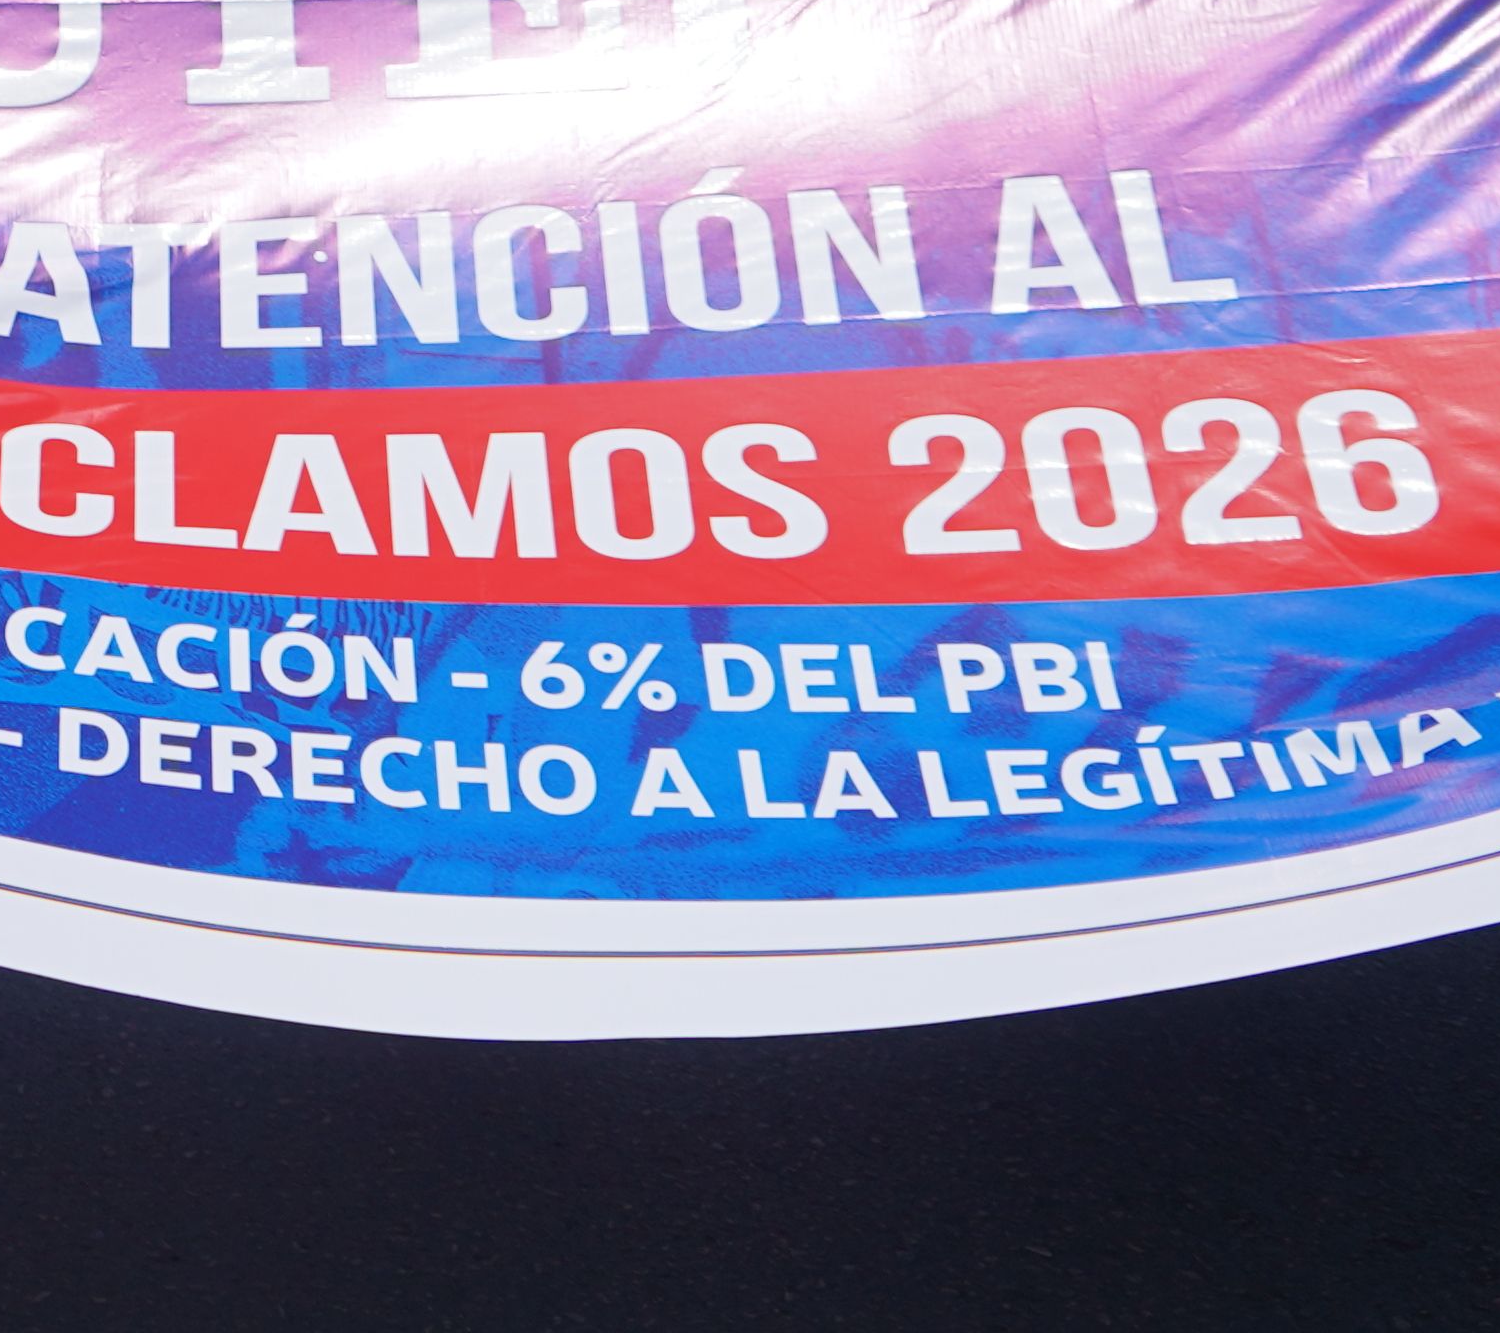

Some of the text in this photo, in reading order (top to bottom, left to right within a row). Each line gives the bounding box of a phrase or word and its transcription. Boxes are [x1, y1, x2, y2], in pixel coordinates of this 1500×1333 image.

[991, 169, 1239, 316] AL
[886, 387, 1441, 558] 2026
[519, 641, 678, 714] 6%
[706, 643, 914, 714] DEL
[938, 642, 1121, 715] PBI
[57, 706, 598, 818] DERECHO
[631, 748, 715, 817] A
[739, 748, 898, 820] LA
[923, 704, 1483, 820] LEGÍTIMA
